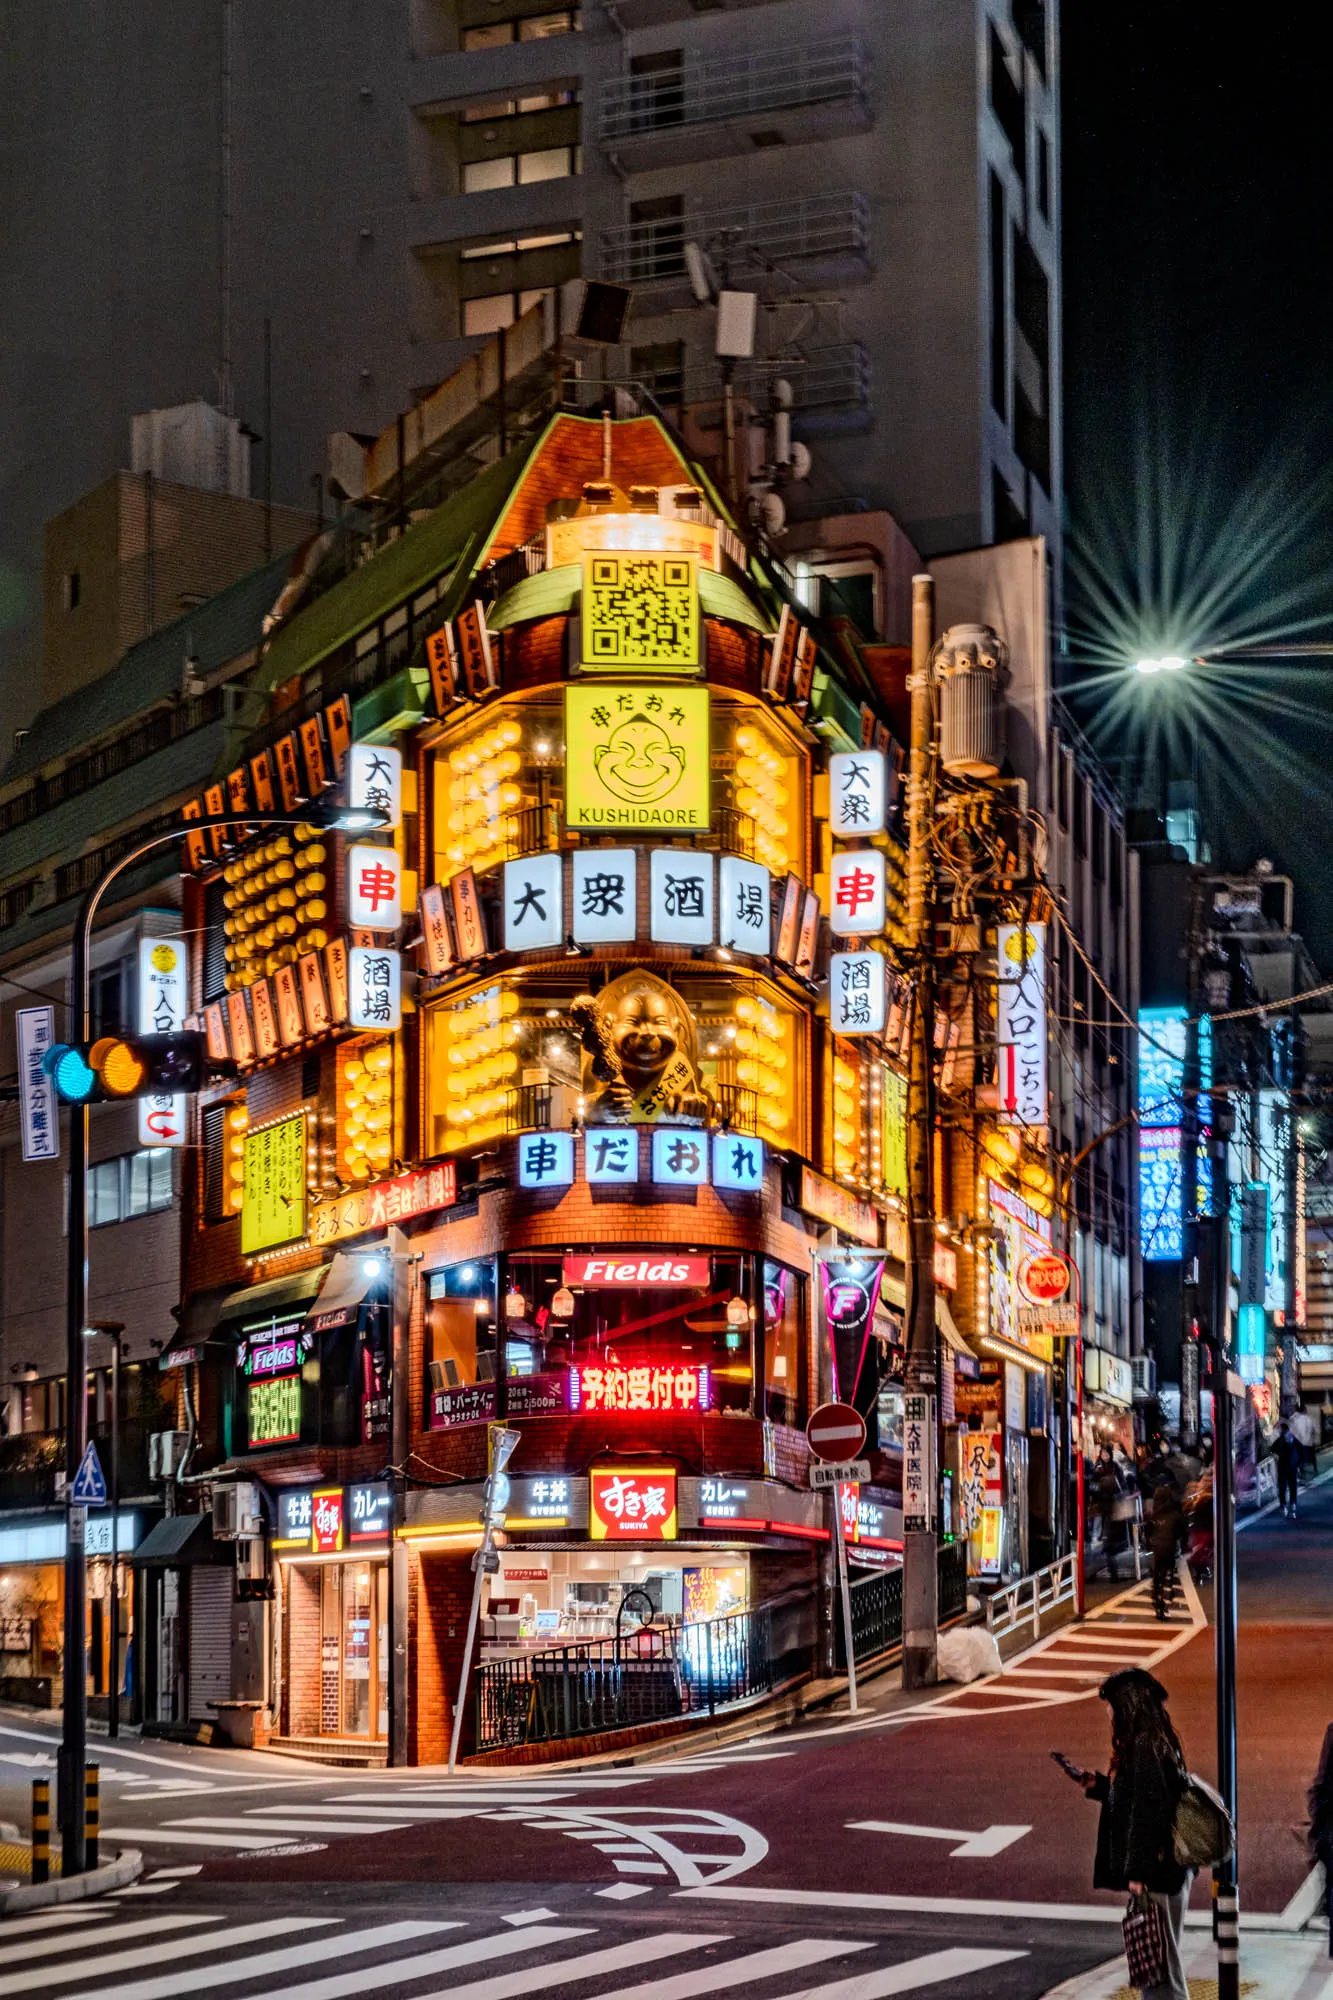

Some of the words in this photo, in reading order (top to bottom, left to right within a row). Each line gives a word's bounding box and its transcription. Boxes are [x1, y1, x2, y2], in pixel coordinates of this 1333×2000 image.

[591, 694, 686, 728] 串だおれ
[579, 808, 697, 824] KUSHIDAORE
[359, 862, 396, 912] 串
[512, 872, 764, 928] 大衆酒場
[836, 866, 875, 917] 串
[362, 955, 392, 1022] 酒場
[841, 960, 871, 1024] 酒場
[640, 1062, 688, 1115] 串だおれ
[526, 1136, 757, 1182] 串だおれ
[583, 1261, 689, 1281] Fields
[252, 1344, 294, 1370] Fields
[582, 1368, 697, 1408] 予約受付中
[906, 1423, 922, 1491] 大平医院
[532, 1480, 567, 1503] 牛丼
[701, 1481, 747, 1503] カレー
[815, 1466, 866, 1484] 自転車を除く
[287, 1495, 312, 1526] 牛丼
[354, 1490, 390, 1519] カレー
[600, 1476, 667, 1521] すき家
[706, 1506, 736, 1517] CURRY
[619, 1522, 648, 1530] SUKIYA
